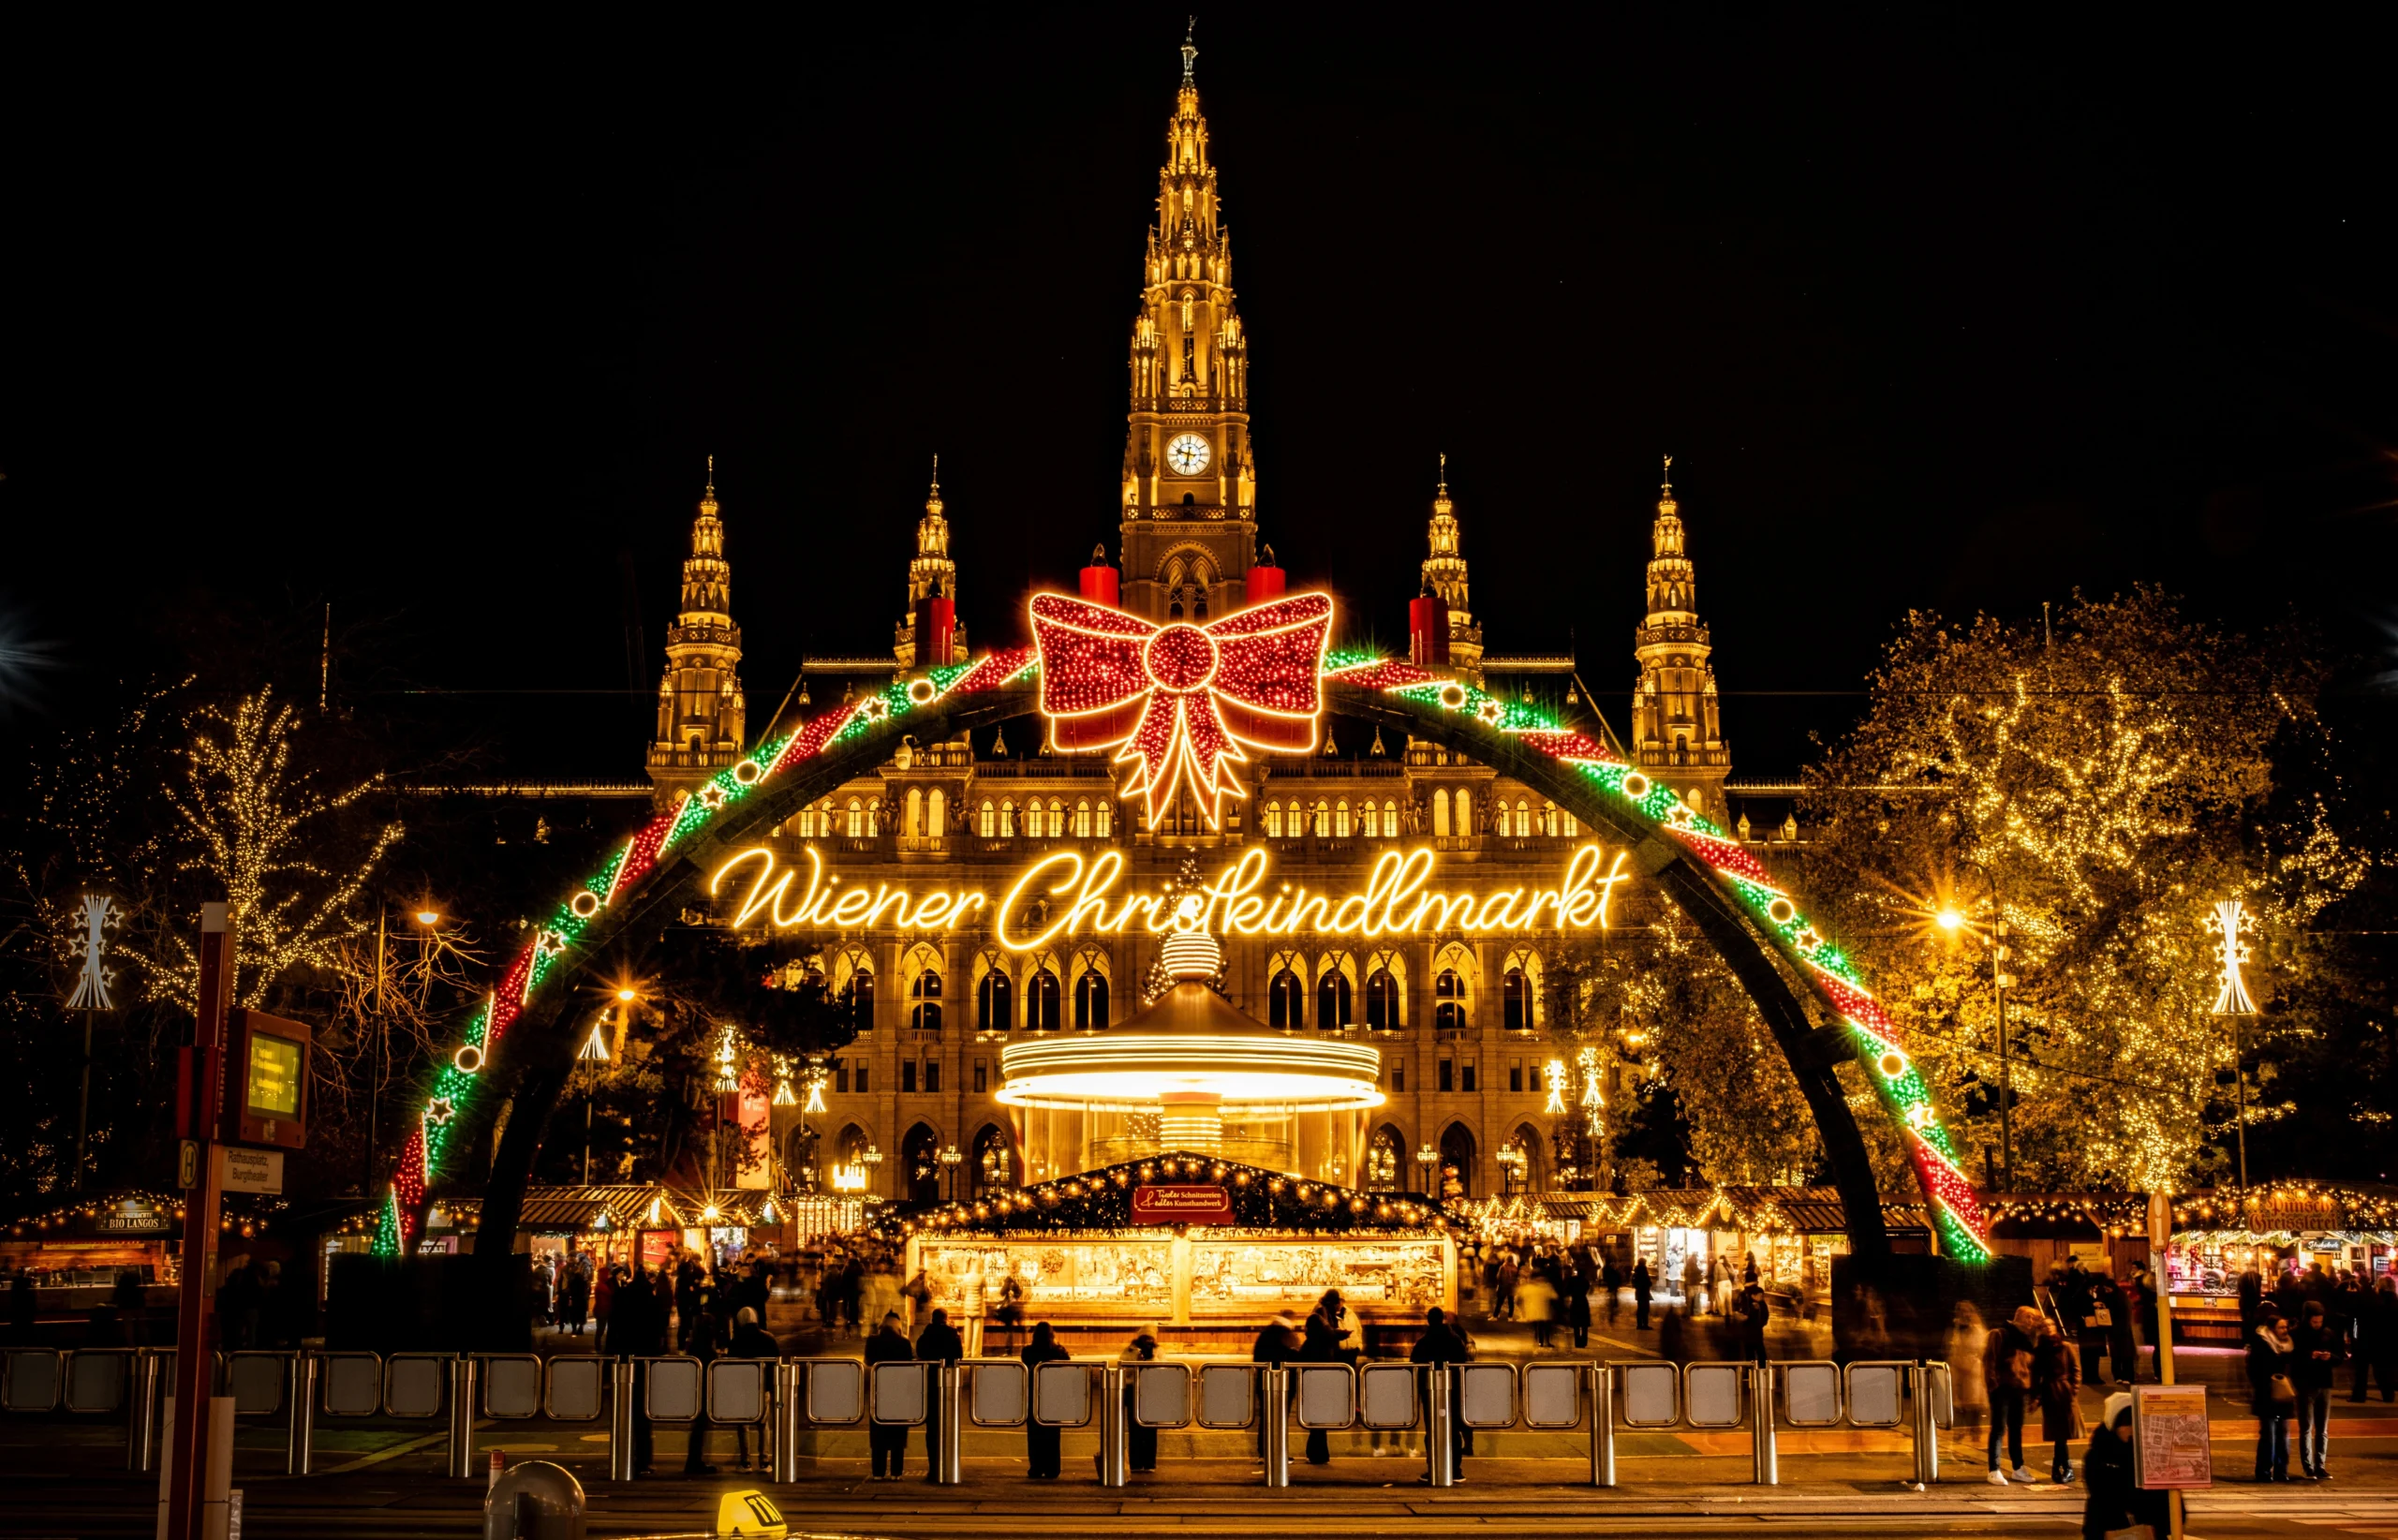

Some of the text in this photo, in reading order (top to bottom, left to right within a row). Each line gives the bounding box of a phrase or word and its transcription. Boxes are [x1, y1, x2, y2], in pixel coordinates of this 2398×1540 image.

[709, 842, 1630, 953] Wiener Christkindlmarkt
[217, 985, 231, 1115] WIENER LINIEN
[228, 1150, 270, 1169] Rathausplatz,
[232, 1167, 269, 1184] Burgtheater
[1154, 1198, 1174, 1207] edles
[1174, 1199, 1222, 1207] Kunsthandwerk
[1180, 1191, 1221, 1199] Schnitzereien
[2267, 1196, 2332, 1217] Punsch
[109, 1218, 159, 1229] BIO LANGOS
[2249, 1211, 2338, 1236] Greisslerei
